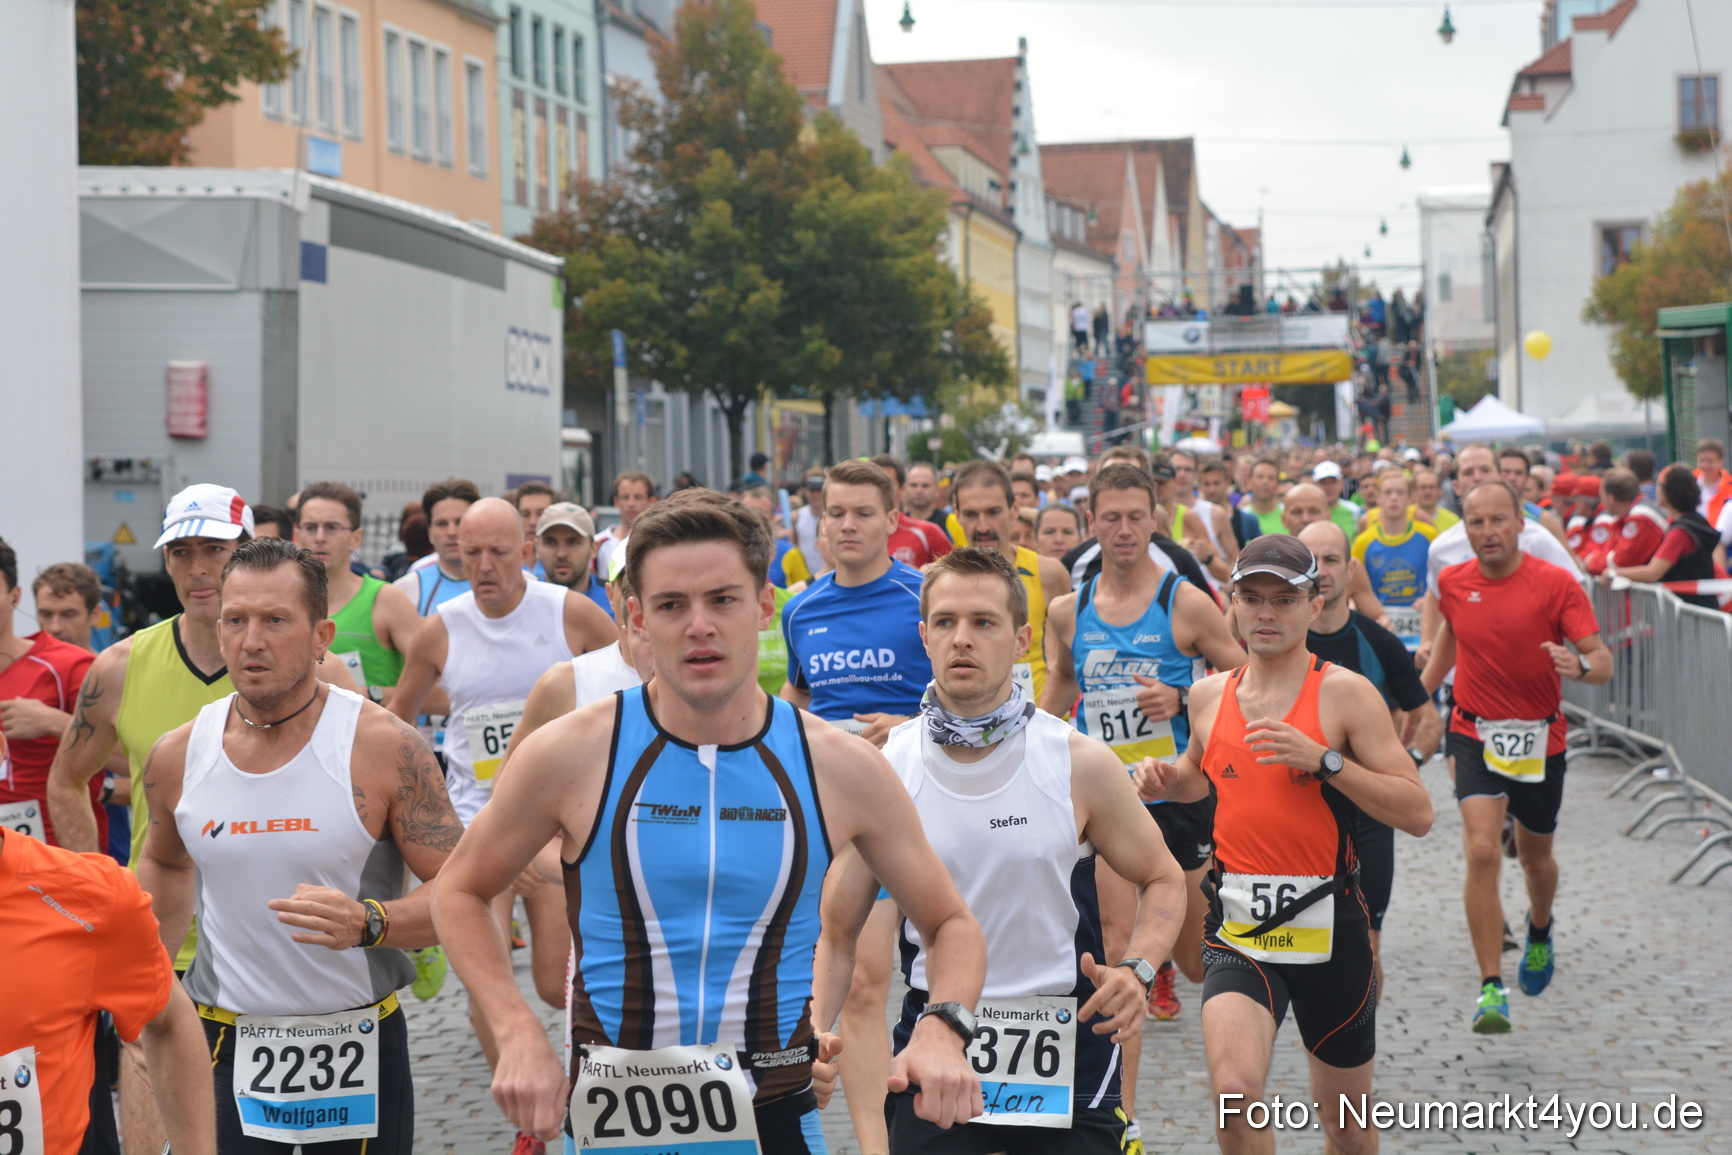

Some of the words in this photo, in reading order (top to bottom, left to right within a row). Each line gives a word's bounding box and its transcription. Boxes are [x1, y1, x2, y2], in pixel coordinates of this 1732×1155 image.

[1213, 359, 1283, 377] START
[809, 648, 896, 675] SYSCAD
[810, 673, 903, 688] www.metallbau-cad.de
[1107, 697, 1136, 706] Neuma
[1100, 707, 1152, 742] 612
[484, 723, 513, 755] 65
[1492, 732, 1535, 756] 626
[230, 818, 319, 834] KLEBL
[990, 815, 1028, 829] Stefan
[1251, 882, 1297, 921] 56
[42, 895, 95, 932] BROOKS
[982, 1007, 1050, 1022] Neumarkt
[286, 1023, 352, 1038] Neumarkt
[751, 1046, 808, 1060] SYNERGY
[971, 1025, 1060, 1078] 376
[250, 1041, 364, 1094] 2232
[626, 1059, 711, 1077] Neumarkt
[586, 1080, 737, 1138] 2090
[982, 1082, 1045, 1116] efan
[263, 1105, 349, 1128] Wolfgang
